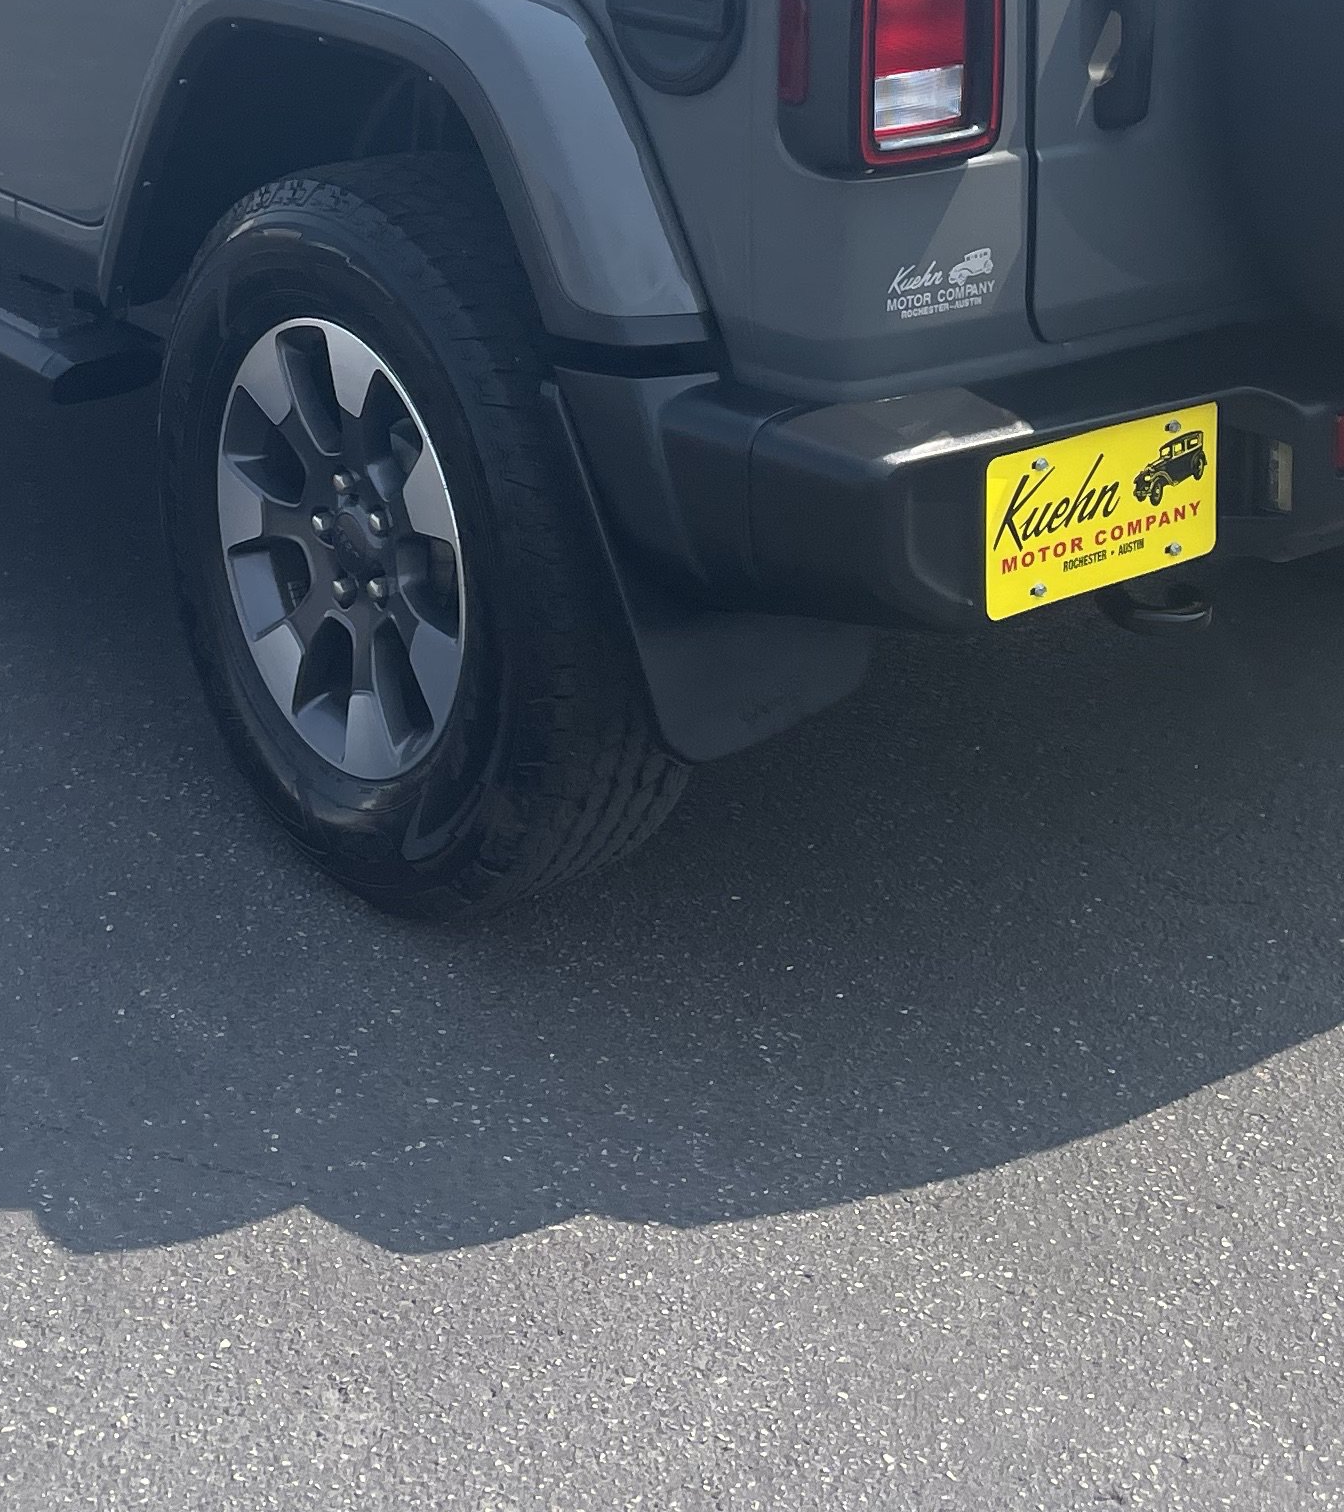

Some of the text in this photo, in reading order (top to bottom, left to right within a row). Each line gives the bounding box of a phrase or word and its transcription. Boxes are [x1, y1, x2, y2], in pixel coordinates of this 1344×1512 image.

[887, 260, 943, 295] Kuehn
[886, 280, 996, 312] MOTOR COMPANY
[992, 453, 1121, 552] Kuehn
[1001, 500, 1201, 575] MOTOR COMPANY
[1062, 538, 1145, 573] ROCHESTER AUSTIN
